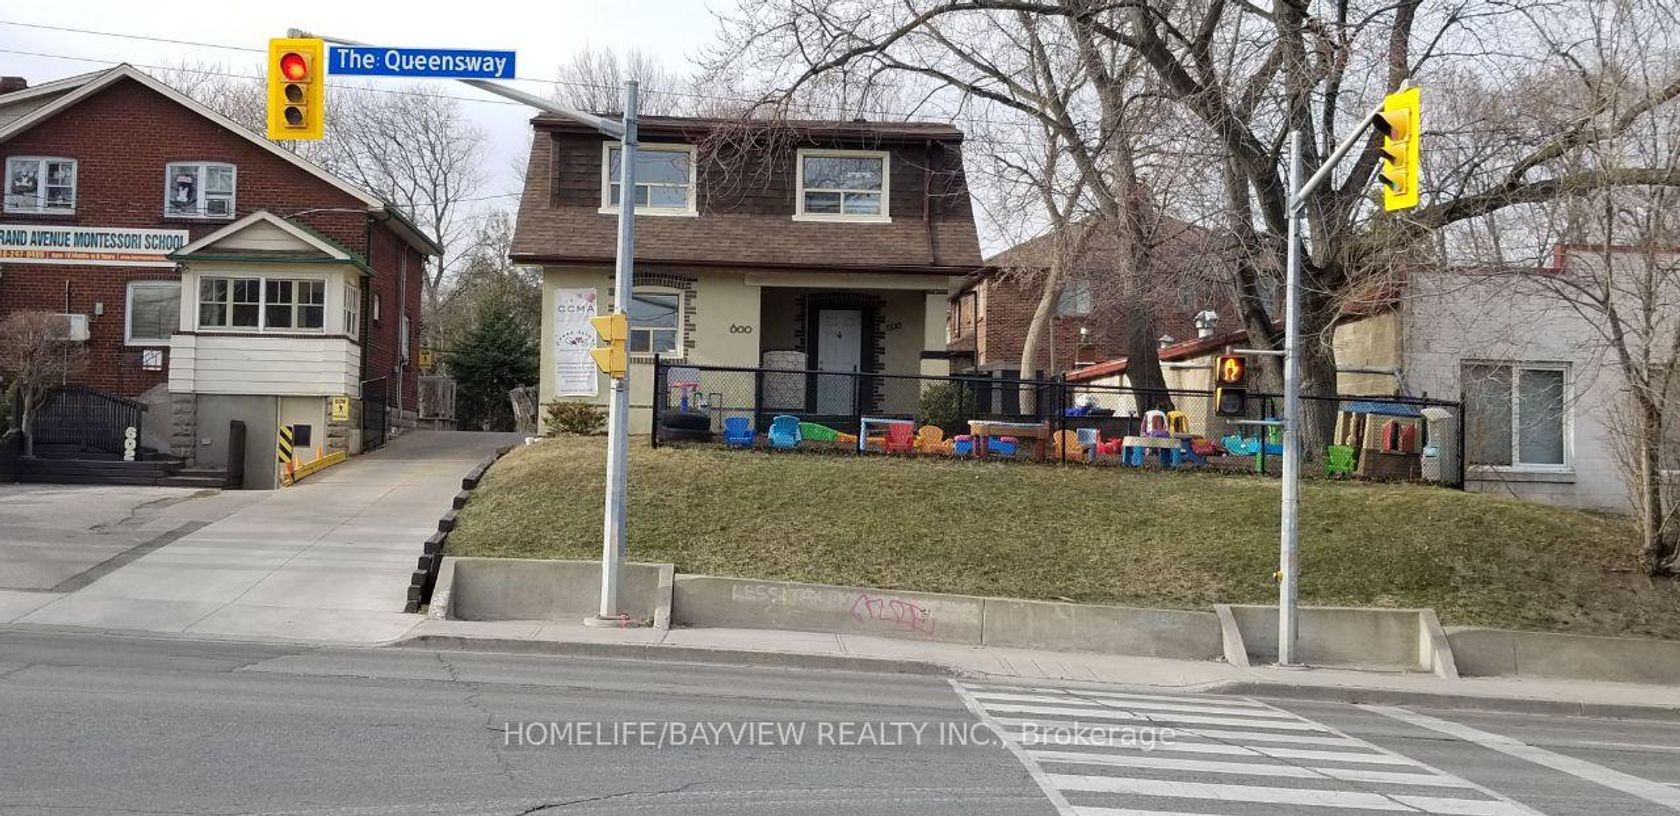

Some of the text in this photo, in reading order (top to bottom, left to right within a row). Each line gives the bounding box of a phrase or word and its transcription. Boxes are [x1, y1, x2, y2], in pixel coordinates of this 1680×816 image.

[384, 50, 507, 77] Queensway
[30, 231, 71, 248] AVENUE
[73, 232, 142, 250] MONTESSORI
[729, 323, 752, 334] 600
[123, 426, 137, 461] 602
